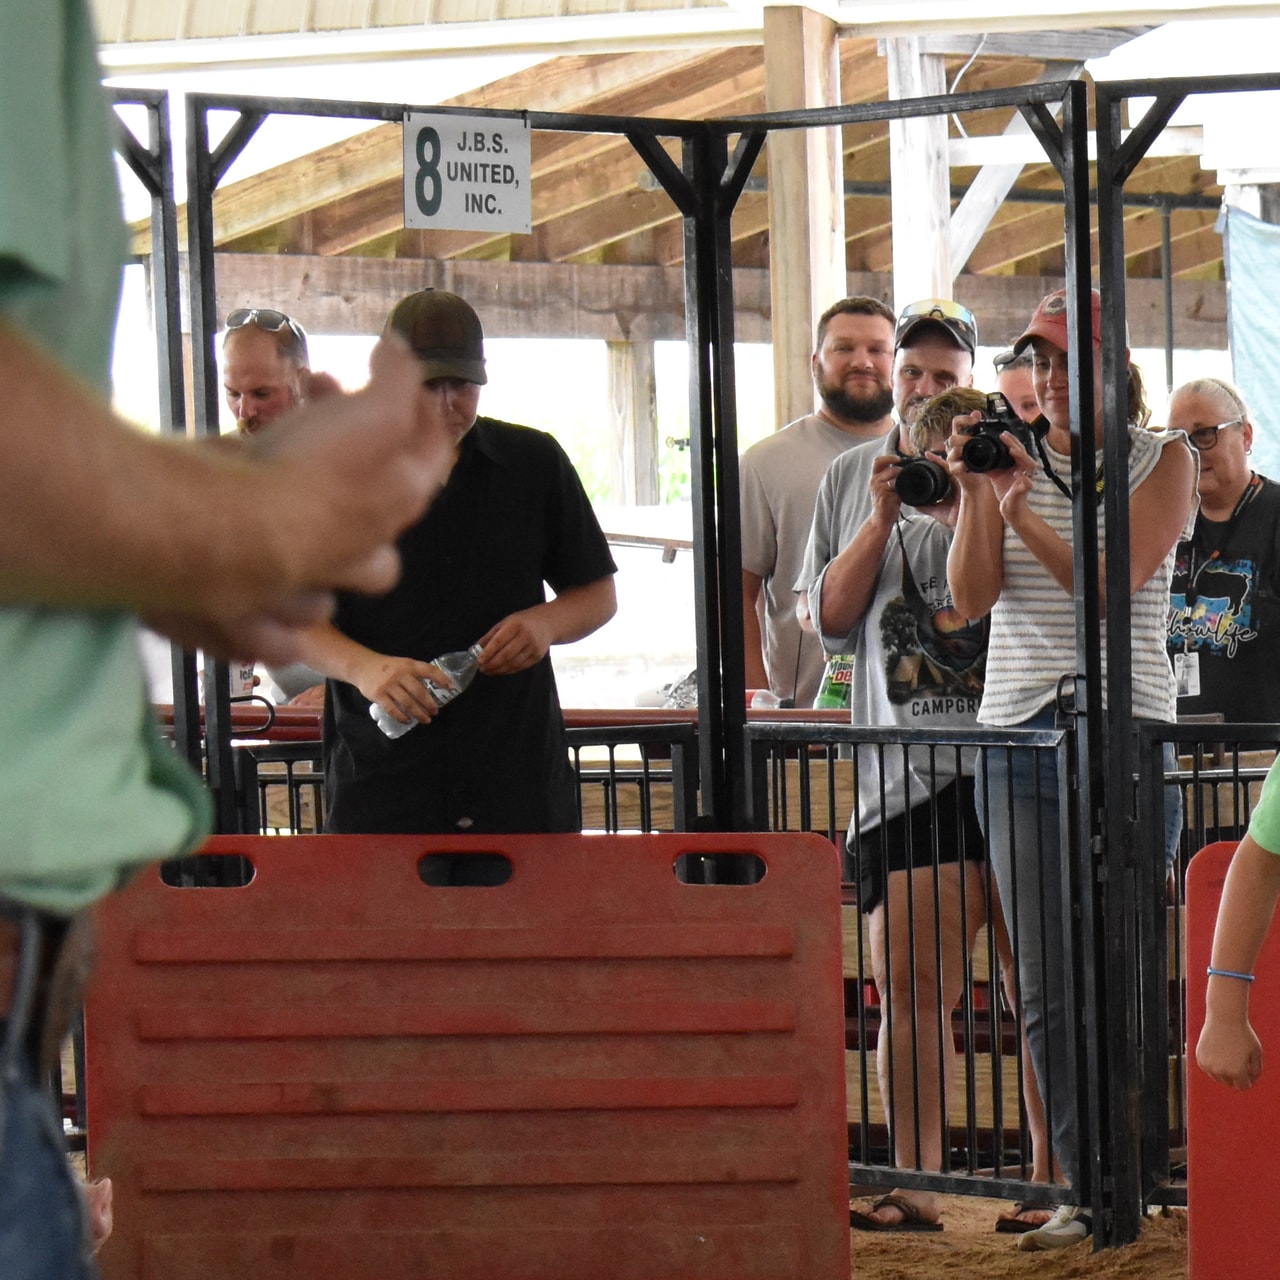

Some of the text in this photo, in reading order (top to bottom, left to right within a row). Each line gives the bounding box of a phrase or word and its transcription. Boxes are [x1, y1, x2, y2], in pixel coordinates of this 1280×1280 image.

[457, 131, 509, 154] J.B.S.
[415, 126, 442, 217] 8
[446, 161, 519, 189] UNITED,
[465, 193, 502, 215] INC.
[912, 699, 980, 716] CAMPGR
